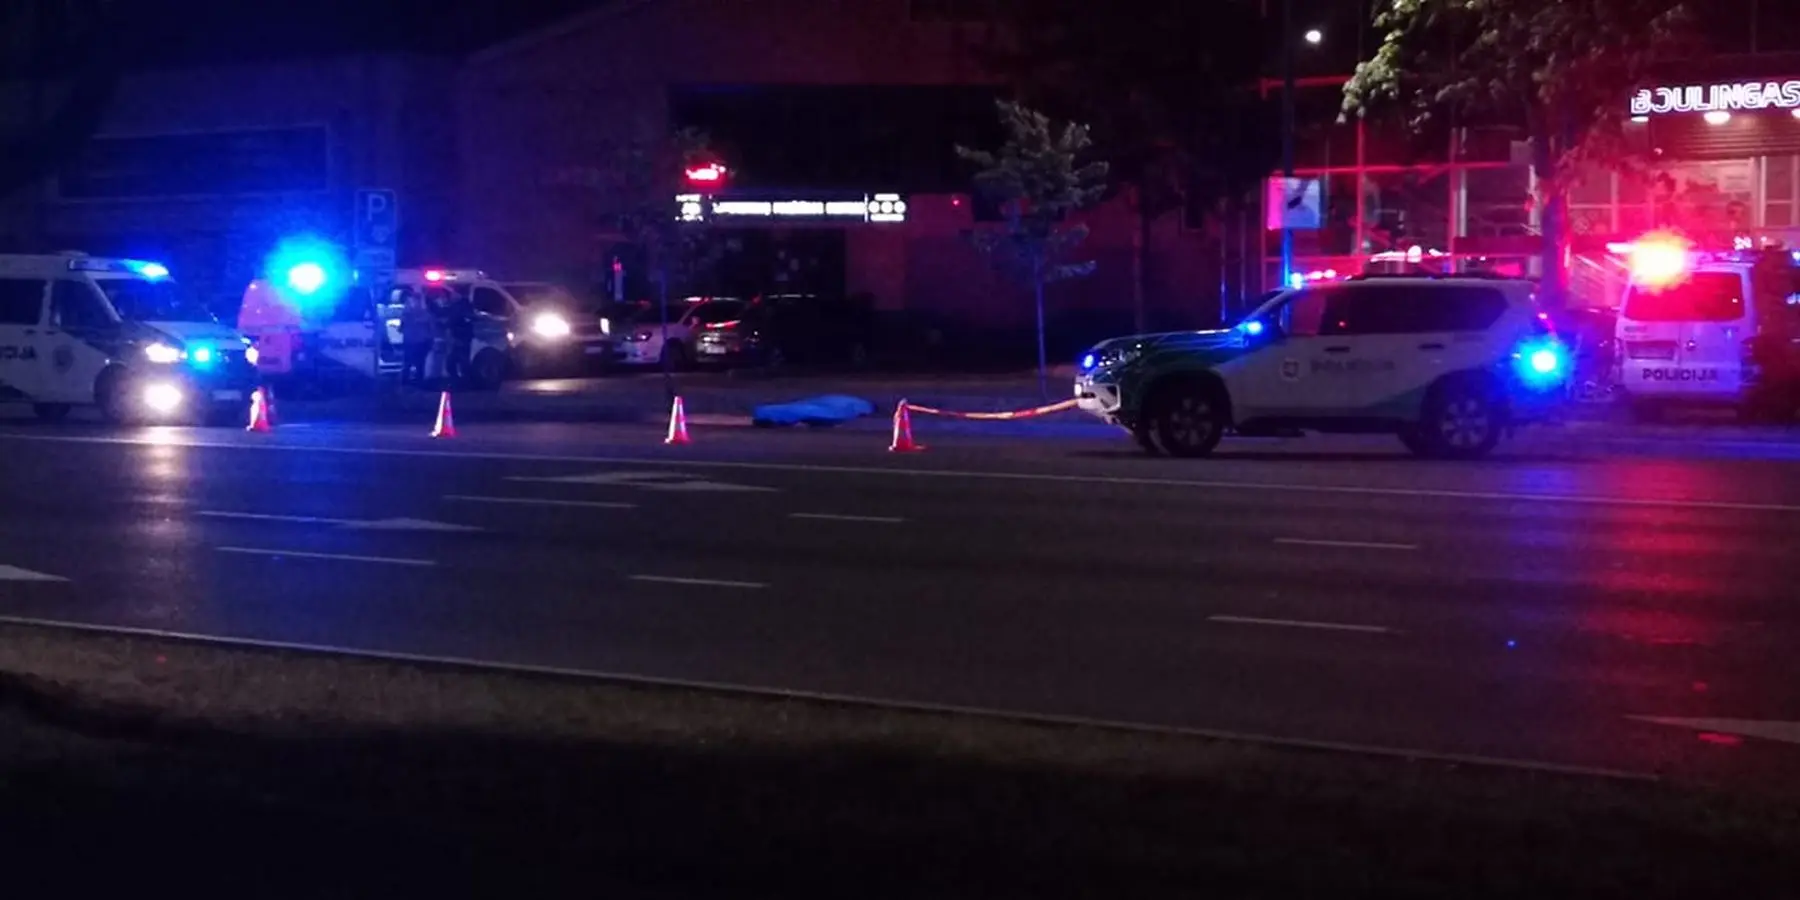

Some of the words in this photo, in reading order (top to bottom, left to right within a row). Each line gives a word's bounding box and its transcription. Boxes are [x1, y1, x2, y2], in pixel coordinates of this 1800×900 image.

[1631, 80, 1800, 114] BOULINGAS
[367, 193, 387, 221] P
[1642, 368, 1718, 381] POLICIJA
